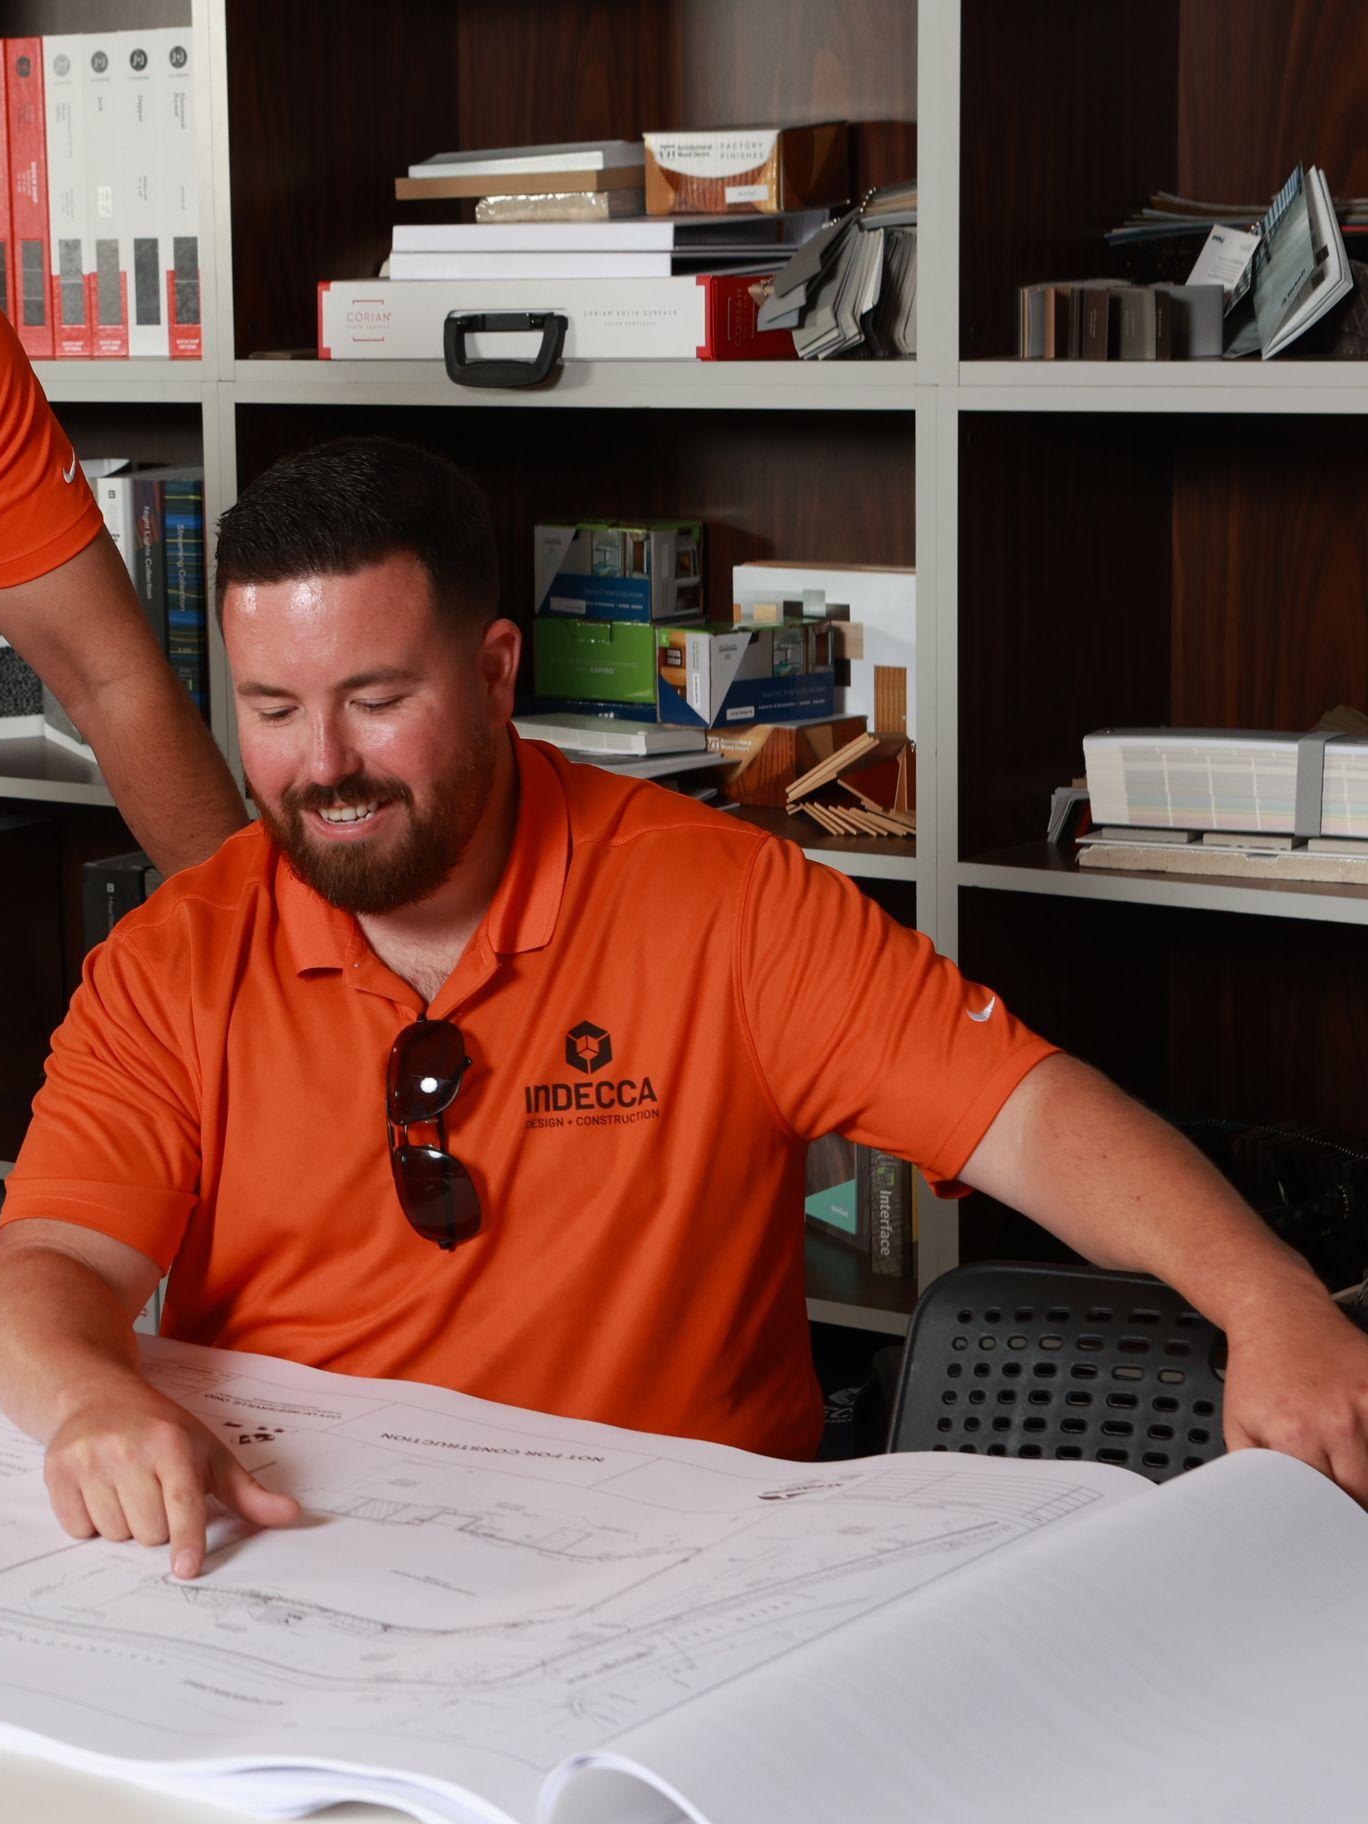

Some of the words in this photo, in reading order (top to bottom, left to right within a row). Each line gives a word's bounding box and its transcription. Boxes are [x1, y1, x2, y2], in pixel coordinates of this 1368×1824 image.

[175, 523, 187, 567] Streaming
[145, 557, 154, 600] Collection
[177, 569, 188, 612] Collection
[525, 1118, 564, 1130] DESIGN
[576, 1109, 660, 1126] CONSTRUCTION
[879, 1190, 895, 1257] Interface
[379, 1432, 520, 1455] CONSTRUCTION
[524, 1449, 563, 1460] FOR
[566, 1454, 605, 1464] NOT
